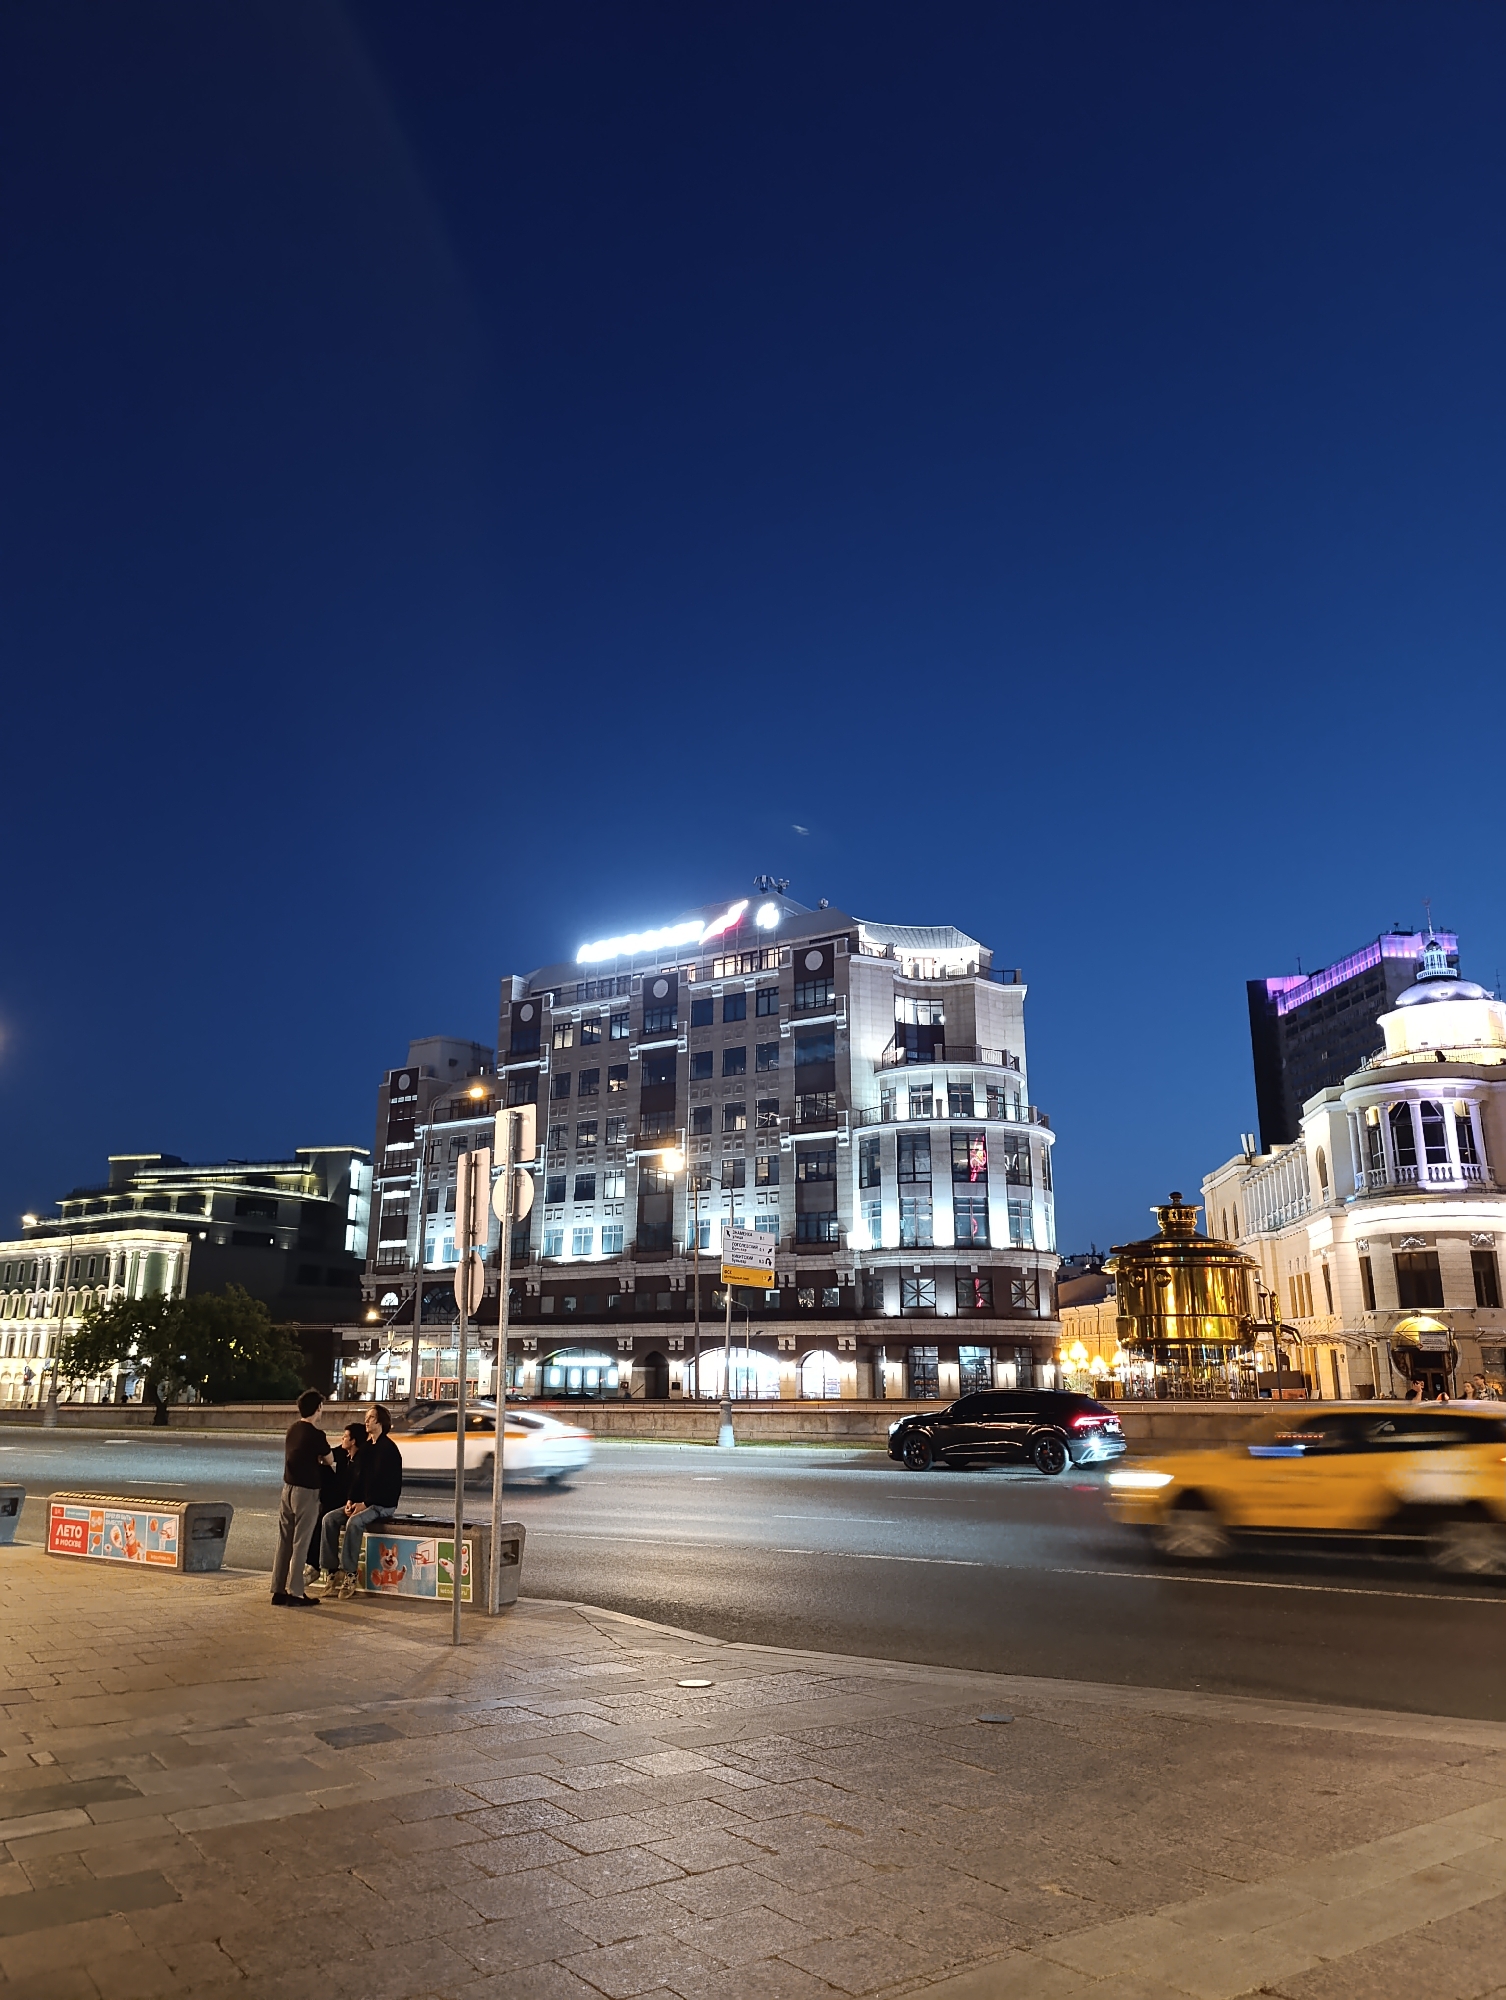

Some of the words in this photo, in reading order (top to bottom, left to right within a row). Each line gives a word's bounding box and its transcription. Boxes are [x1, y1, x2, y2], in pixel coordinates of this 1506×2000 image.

[56, 1524, 82, 1538] ЛЕТО
[55, 1538, 60, 1546] В
[60, 1539, 82, 1549] МОСКВЕ
